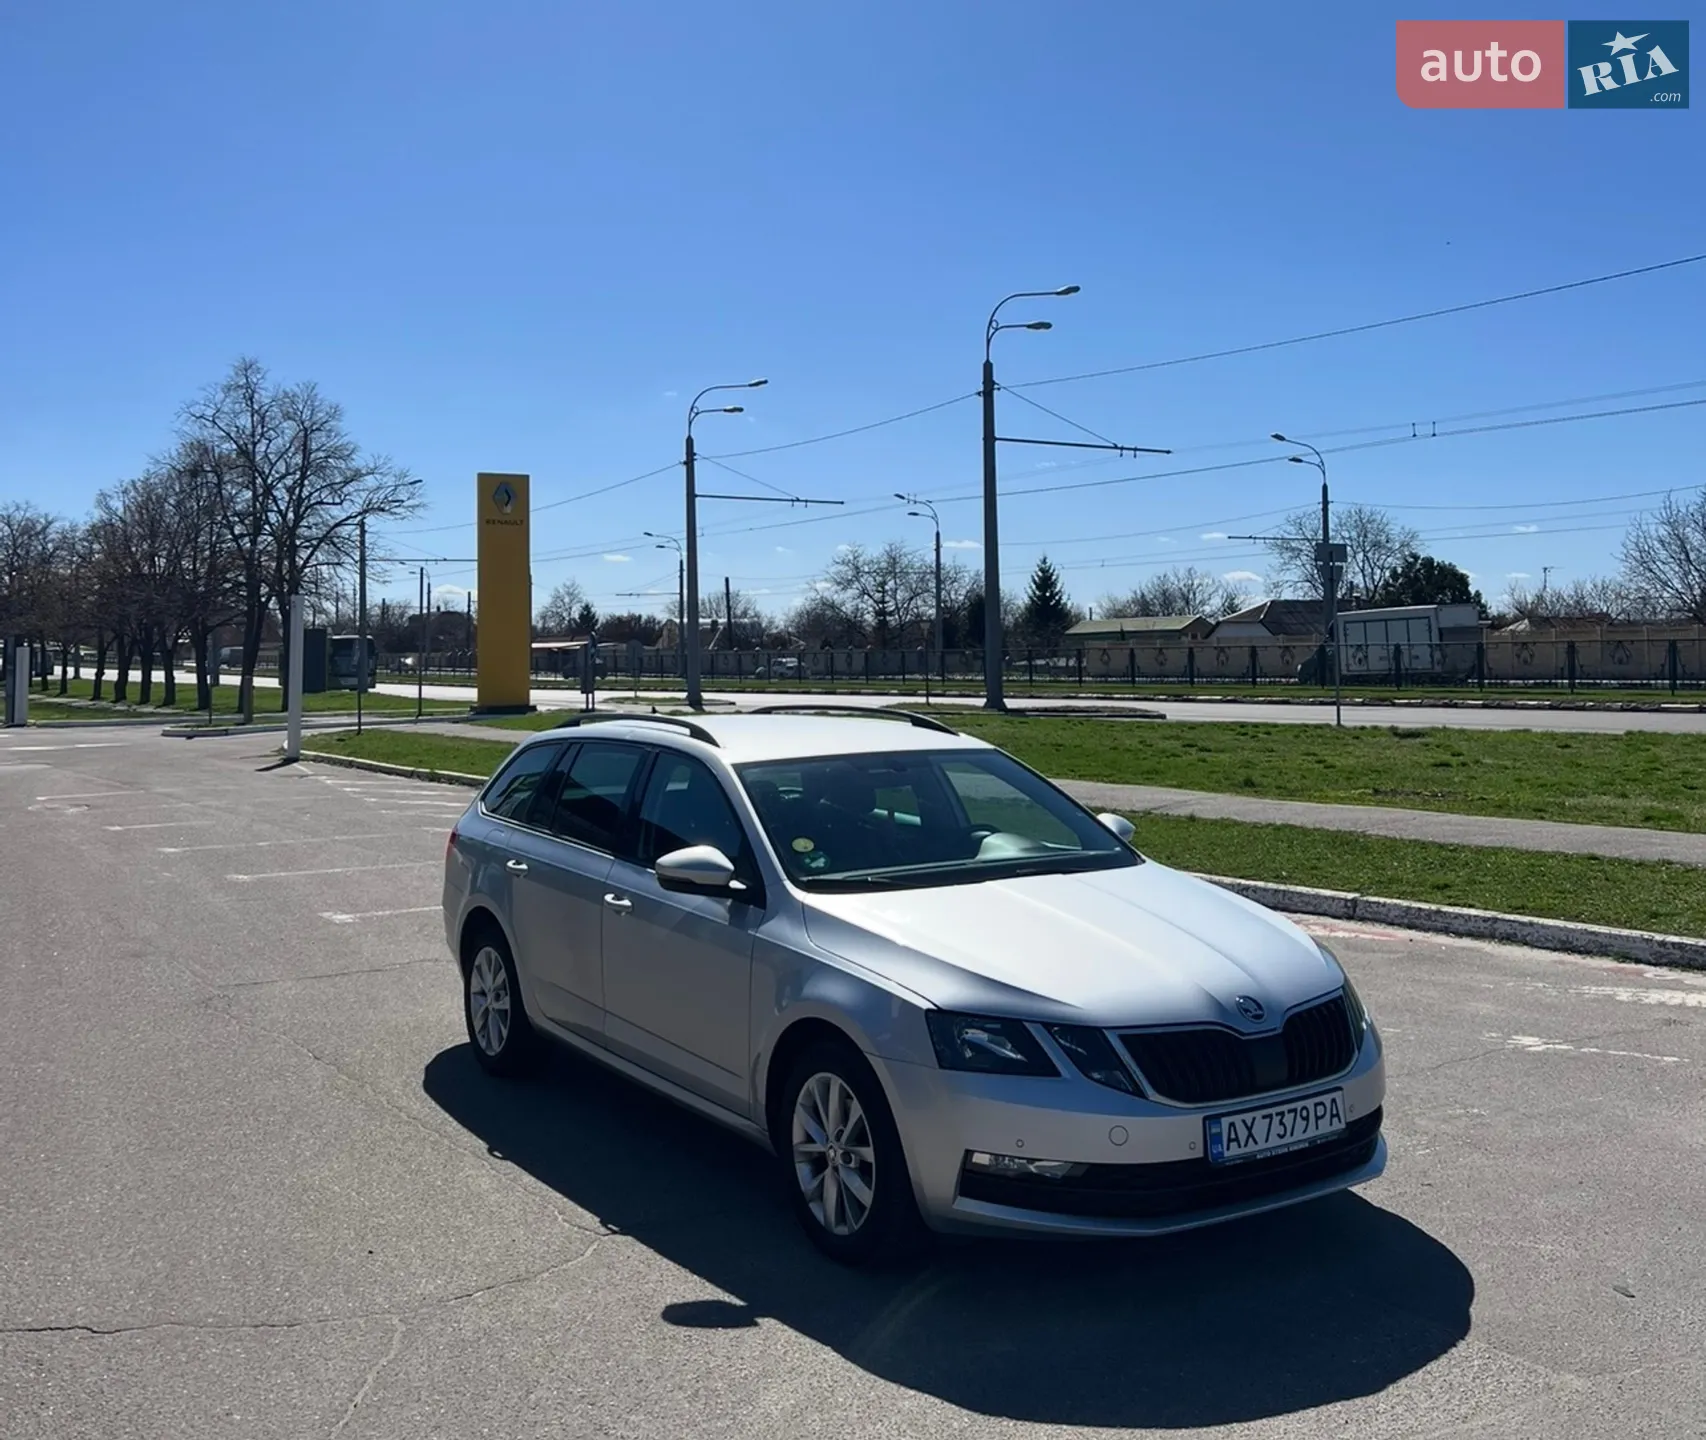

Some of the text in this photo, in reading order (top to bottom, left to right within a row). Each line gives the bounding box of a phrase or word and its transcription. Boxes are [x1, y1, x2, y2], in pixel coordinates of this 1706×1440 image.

[485, 518, 524, 526] RENAULT
[1226, 1116, 1259, 1152] AX
[1261, 1105, 1310, 1144] 7379
[1313, 1097, 1342, 1131] PA
